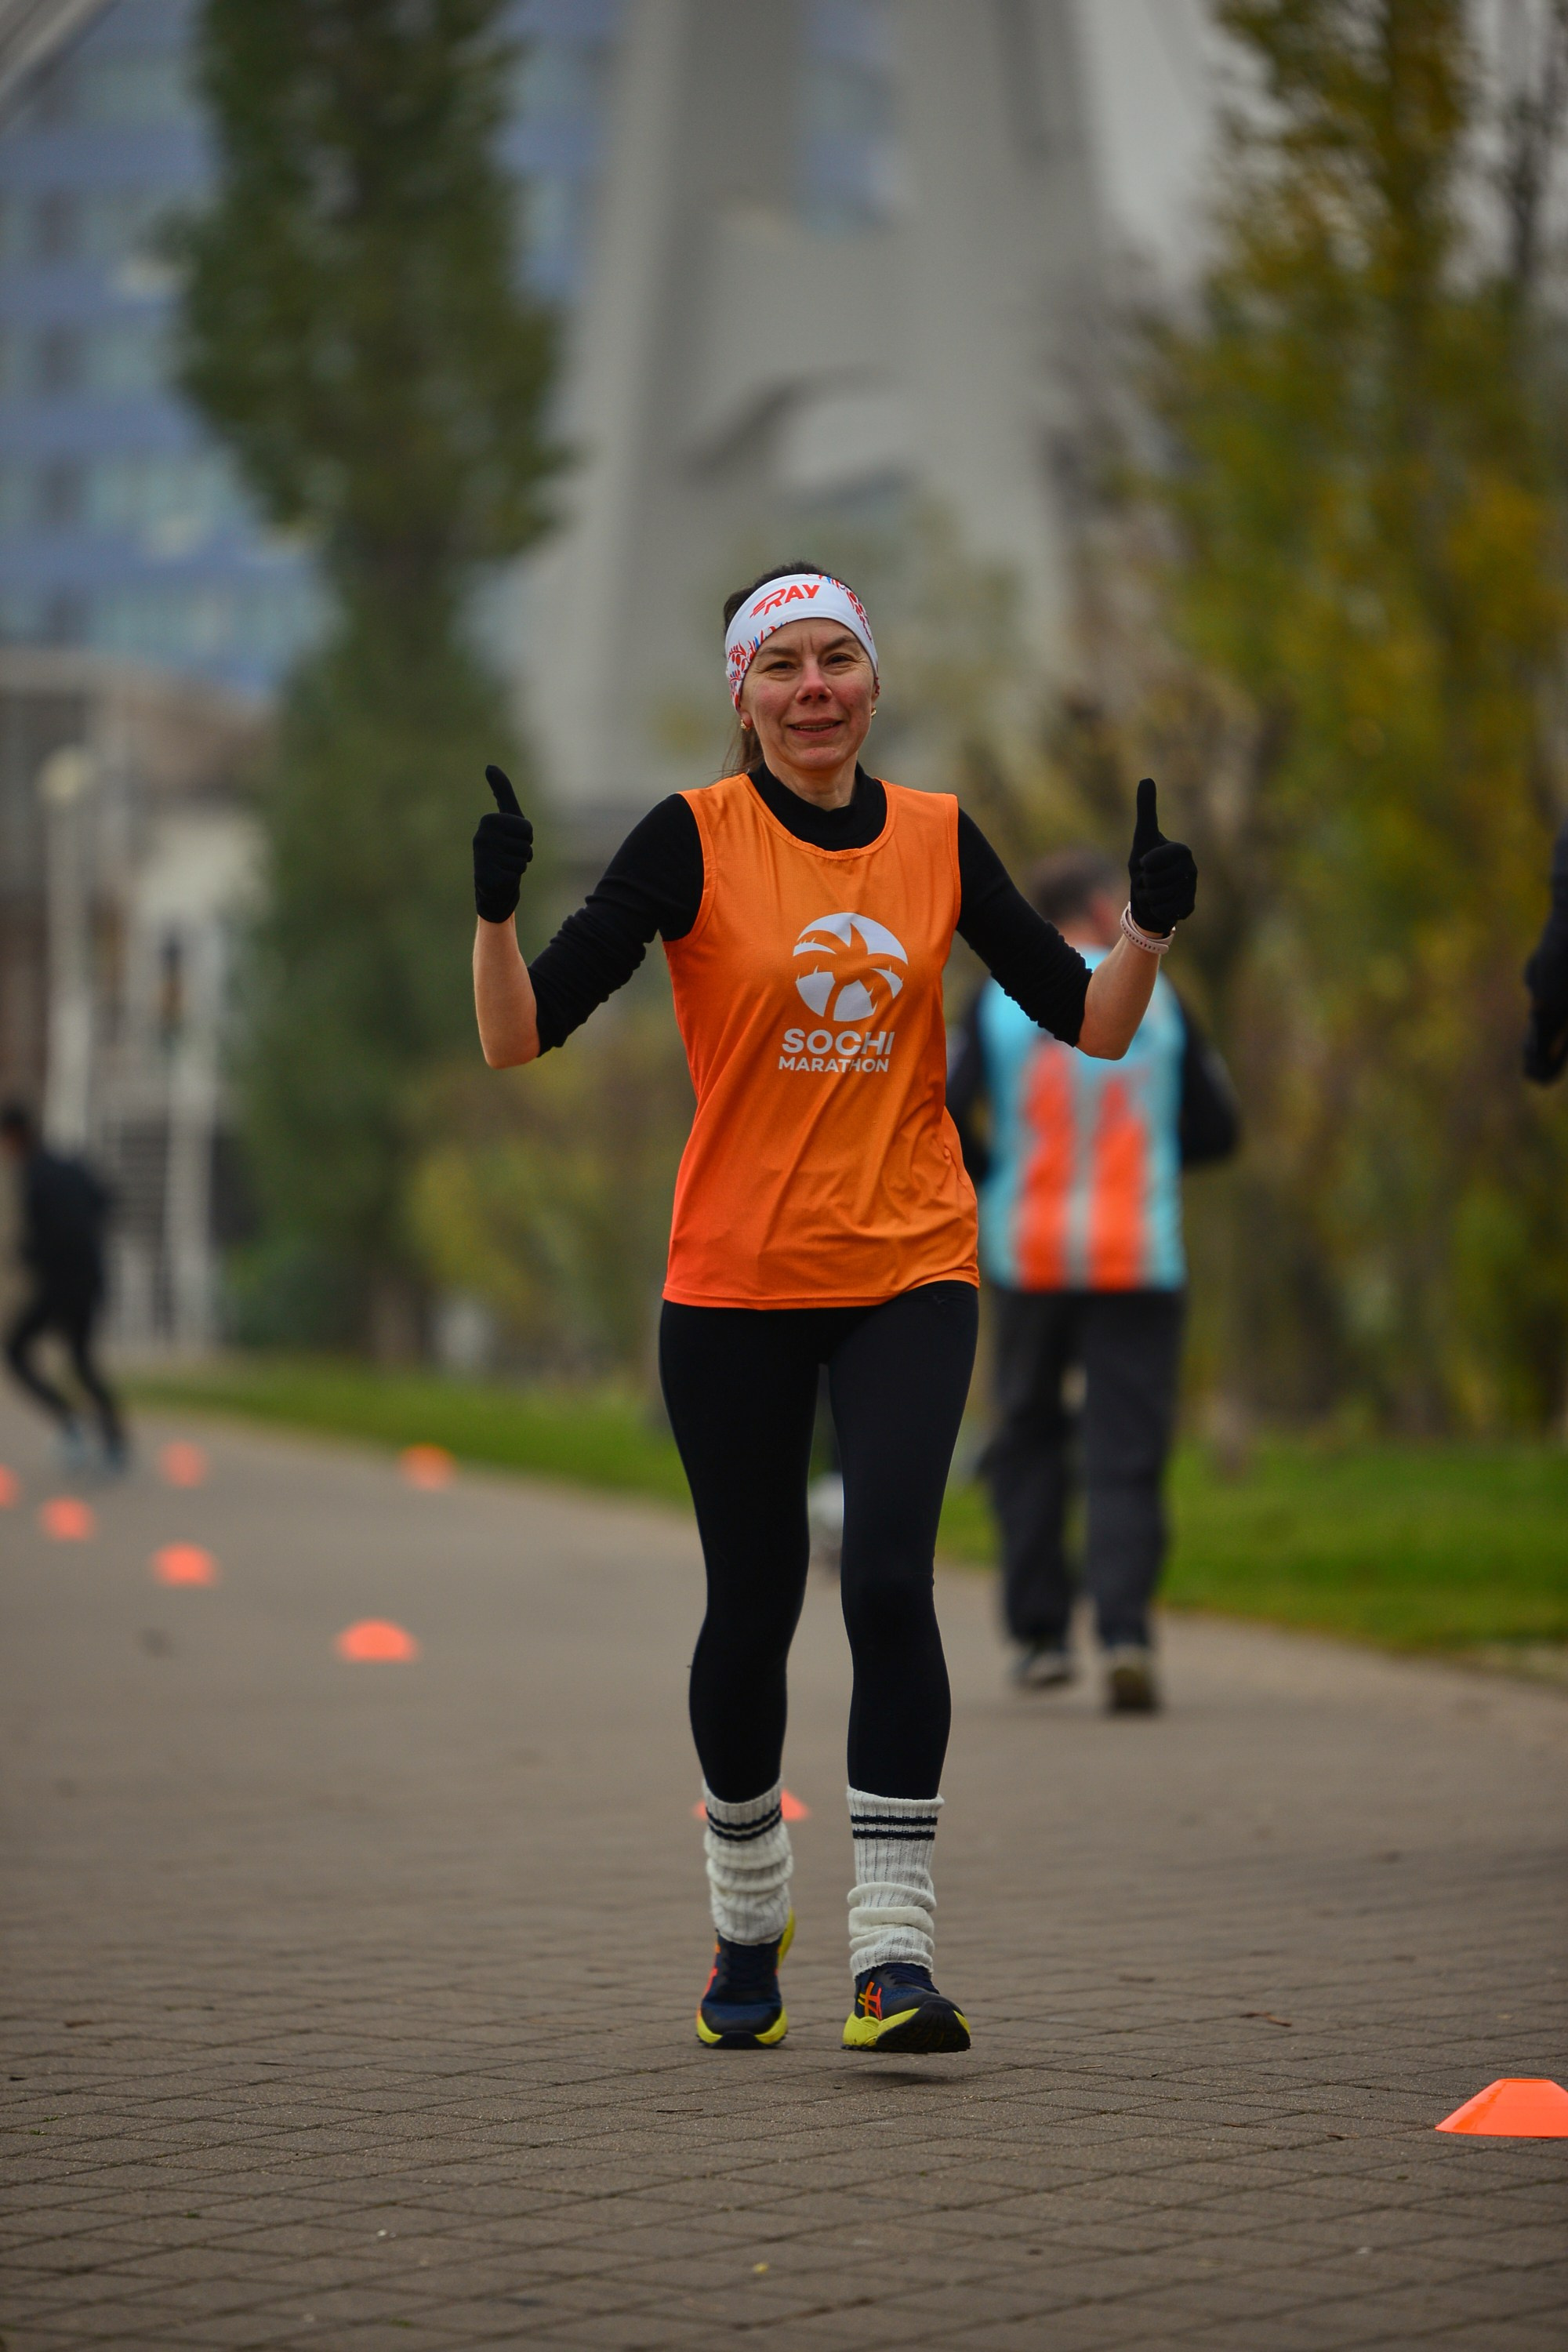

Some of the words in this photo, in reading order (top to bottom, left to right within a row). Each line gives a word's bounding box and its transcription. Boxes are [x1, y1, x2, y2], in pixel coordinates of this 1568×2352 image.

[750, 584, 820, 619] RAY
[782, 1028, 895, 1056] SOCHI
[779, 1056, 890, 1073] MARATHON
